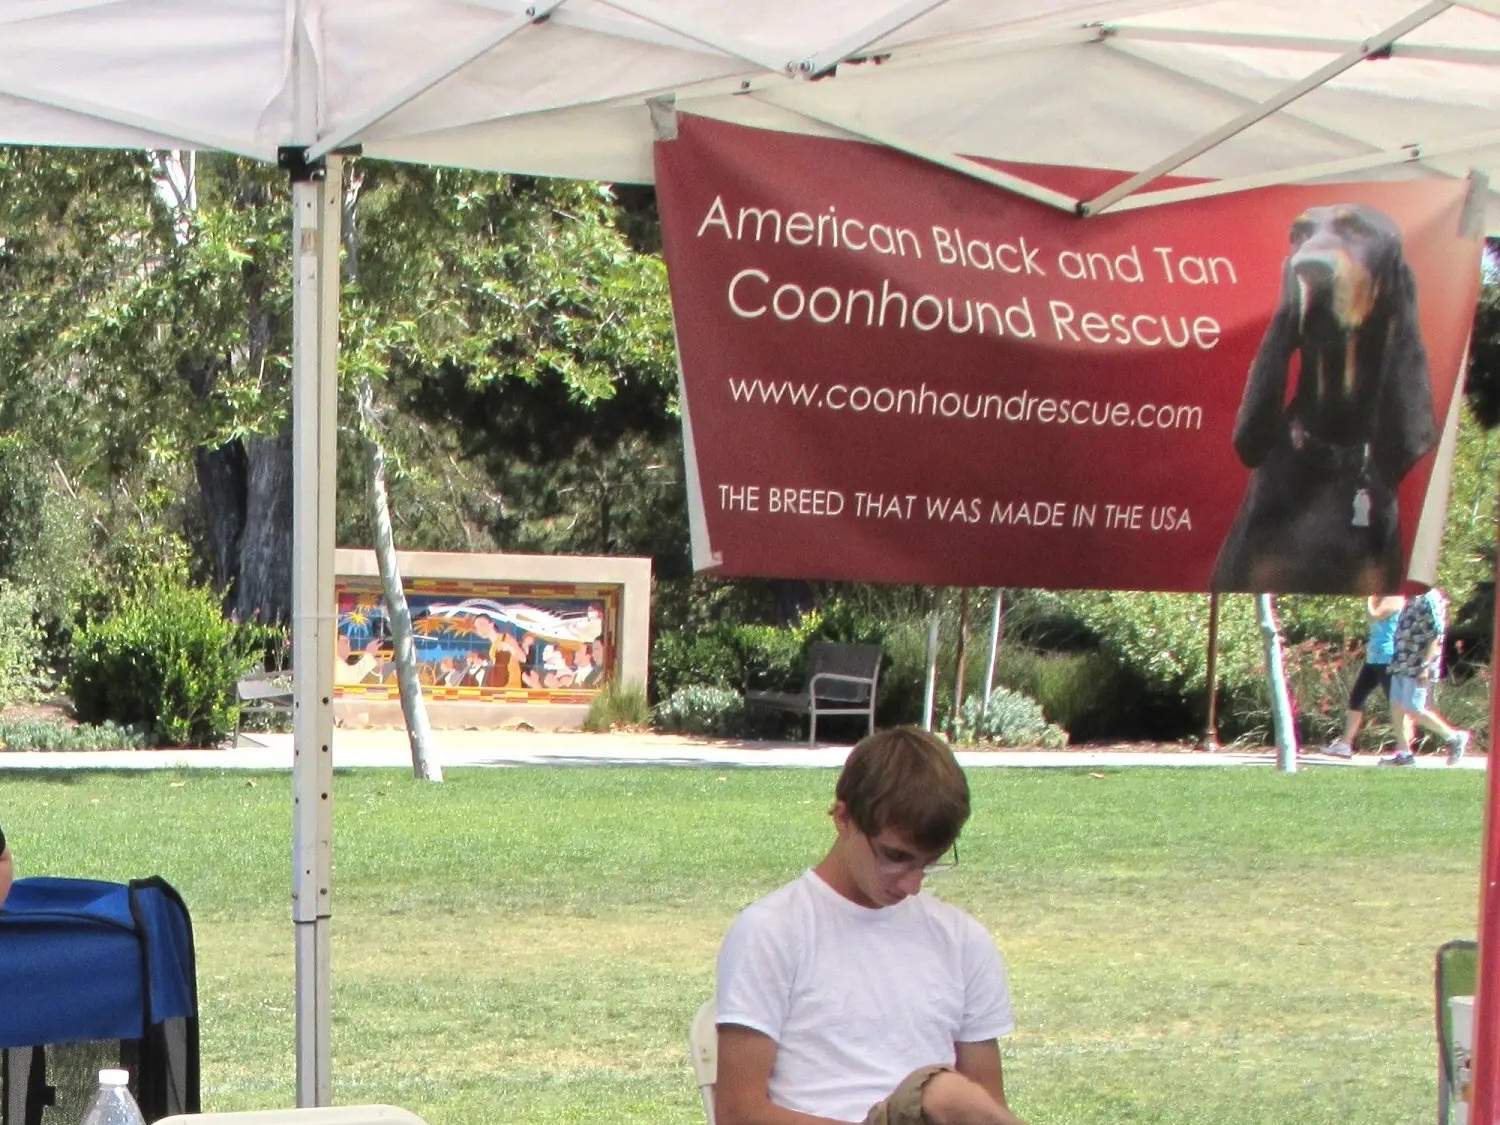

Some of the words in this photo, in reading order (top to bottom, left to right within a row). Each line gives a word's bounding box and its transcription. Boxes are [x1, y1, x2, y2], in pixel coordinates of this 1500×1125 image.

[698, 195, 921, 260] American
[934, 226, 1045, 277] Black
[1058, 249, 1144, 284] and
[1153, 245, 1237, 284] Tan
[728, 269, 1034, 339] Coonhound
[1053, 302, 1221, 350] Rescue
[729, 378, 1202, 431] www.coonhoundrescue.com
[719, 484, 761, 513] THE
[769, 488, 844, 517] BREED
[855, 492, 916, 521] THAT
[926, 497, 981, 525] WAS
[991, 500, 1065, 528] MADE
[1073, 503, 1094, 528] IN
[1105, 505, 1142, 531] THE
[1151, 507, 1192, 531] USA
